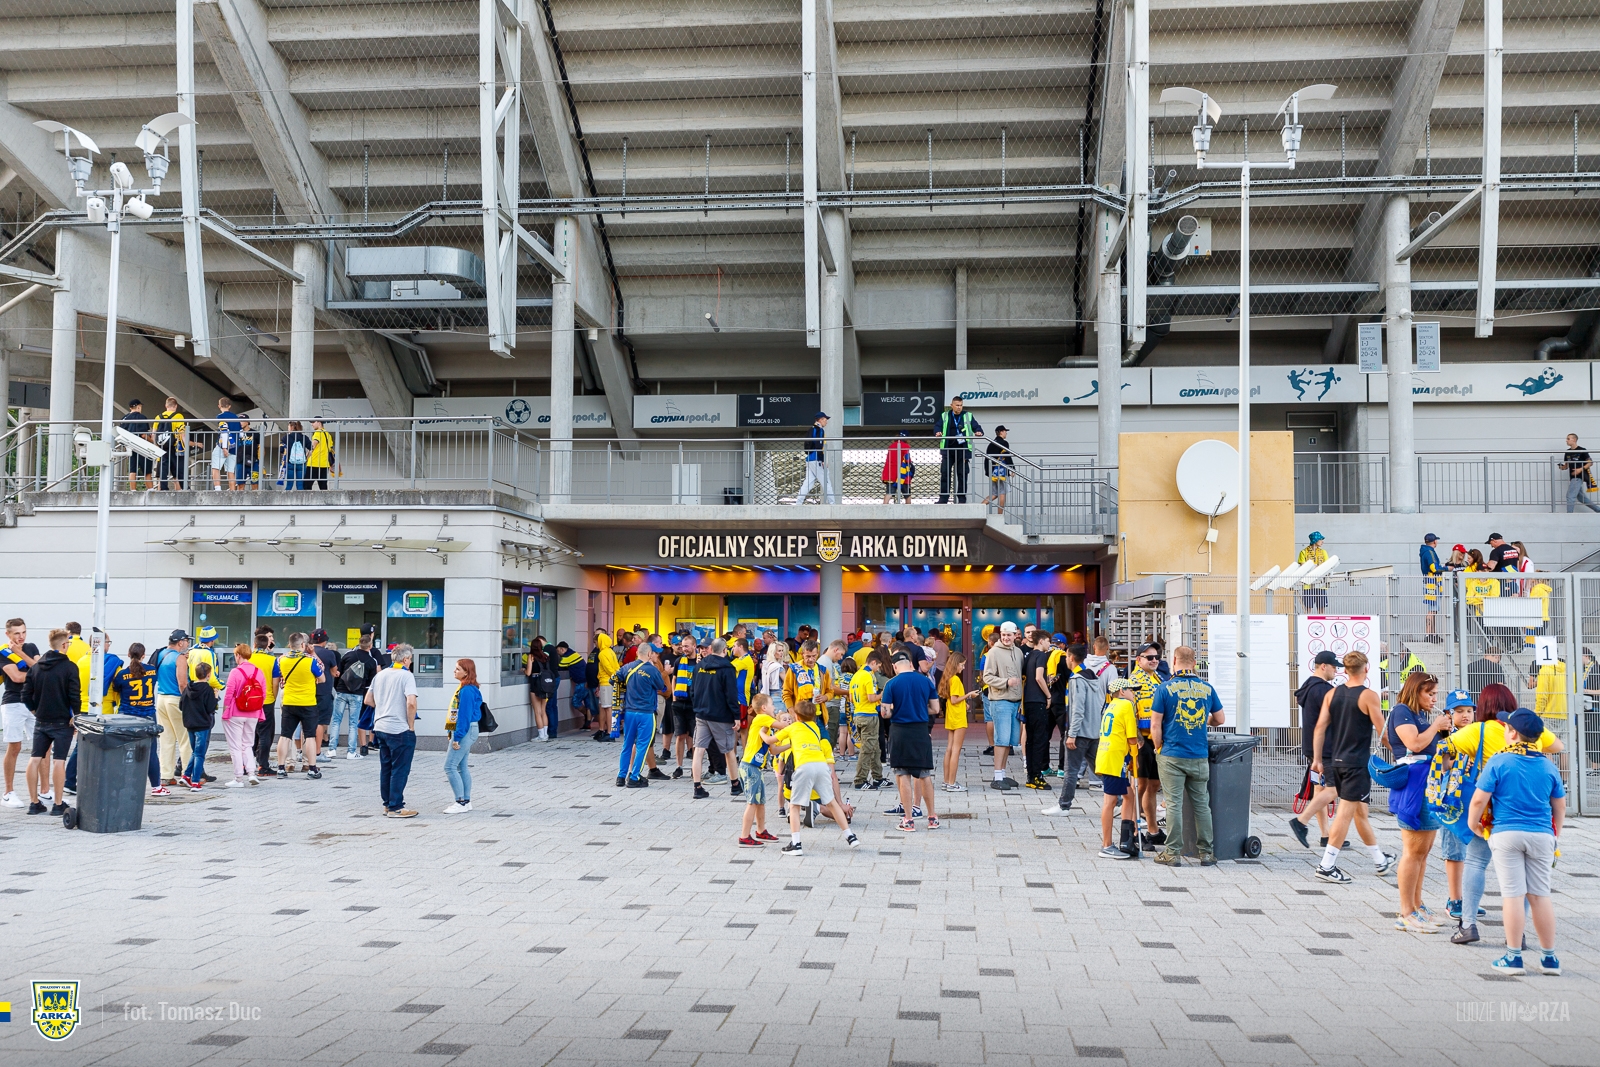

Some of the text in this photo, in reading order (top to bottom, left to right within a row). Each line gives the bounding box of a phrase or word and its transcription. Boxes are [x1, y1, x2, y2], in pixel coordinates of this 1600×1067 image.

[1179, 385, 1261, 398] GDYNIAspopl
[1412, 384, 1473, 396] NIAsport.pl
[754, 397, 764, 417] J
[880, 395, 906, 403] WEJŚCIE
[910, 396, 936, 416] 23
[537, 412, 607, 423] GDsport.pl
[658, 535, 968, 558] OFICJALNY SKLEP ARKA GDYNIA
[1542, 645, 1552, 661] 1
[128, 678, 153, 700] 31
